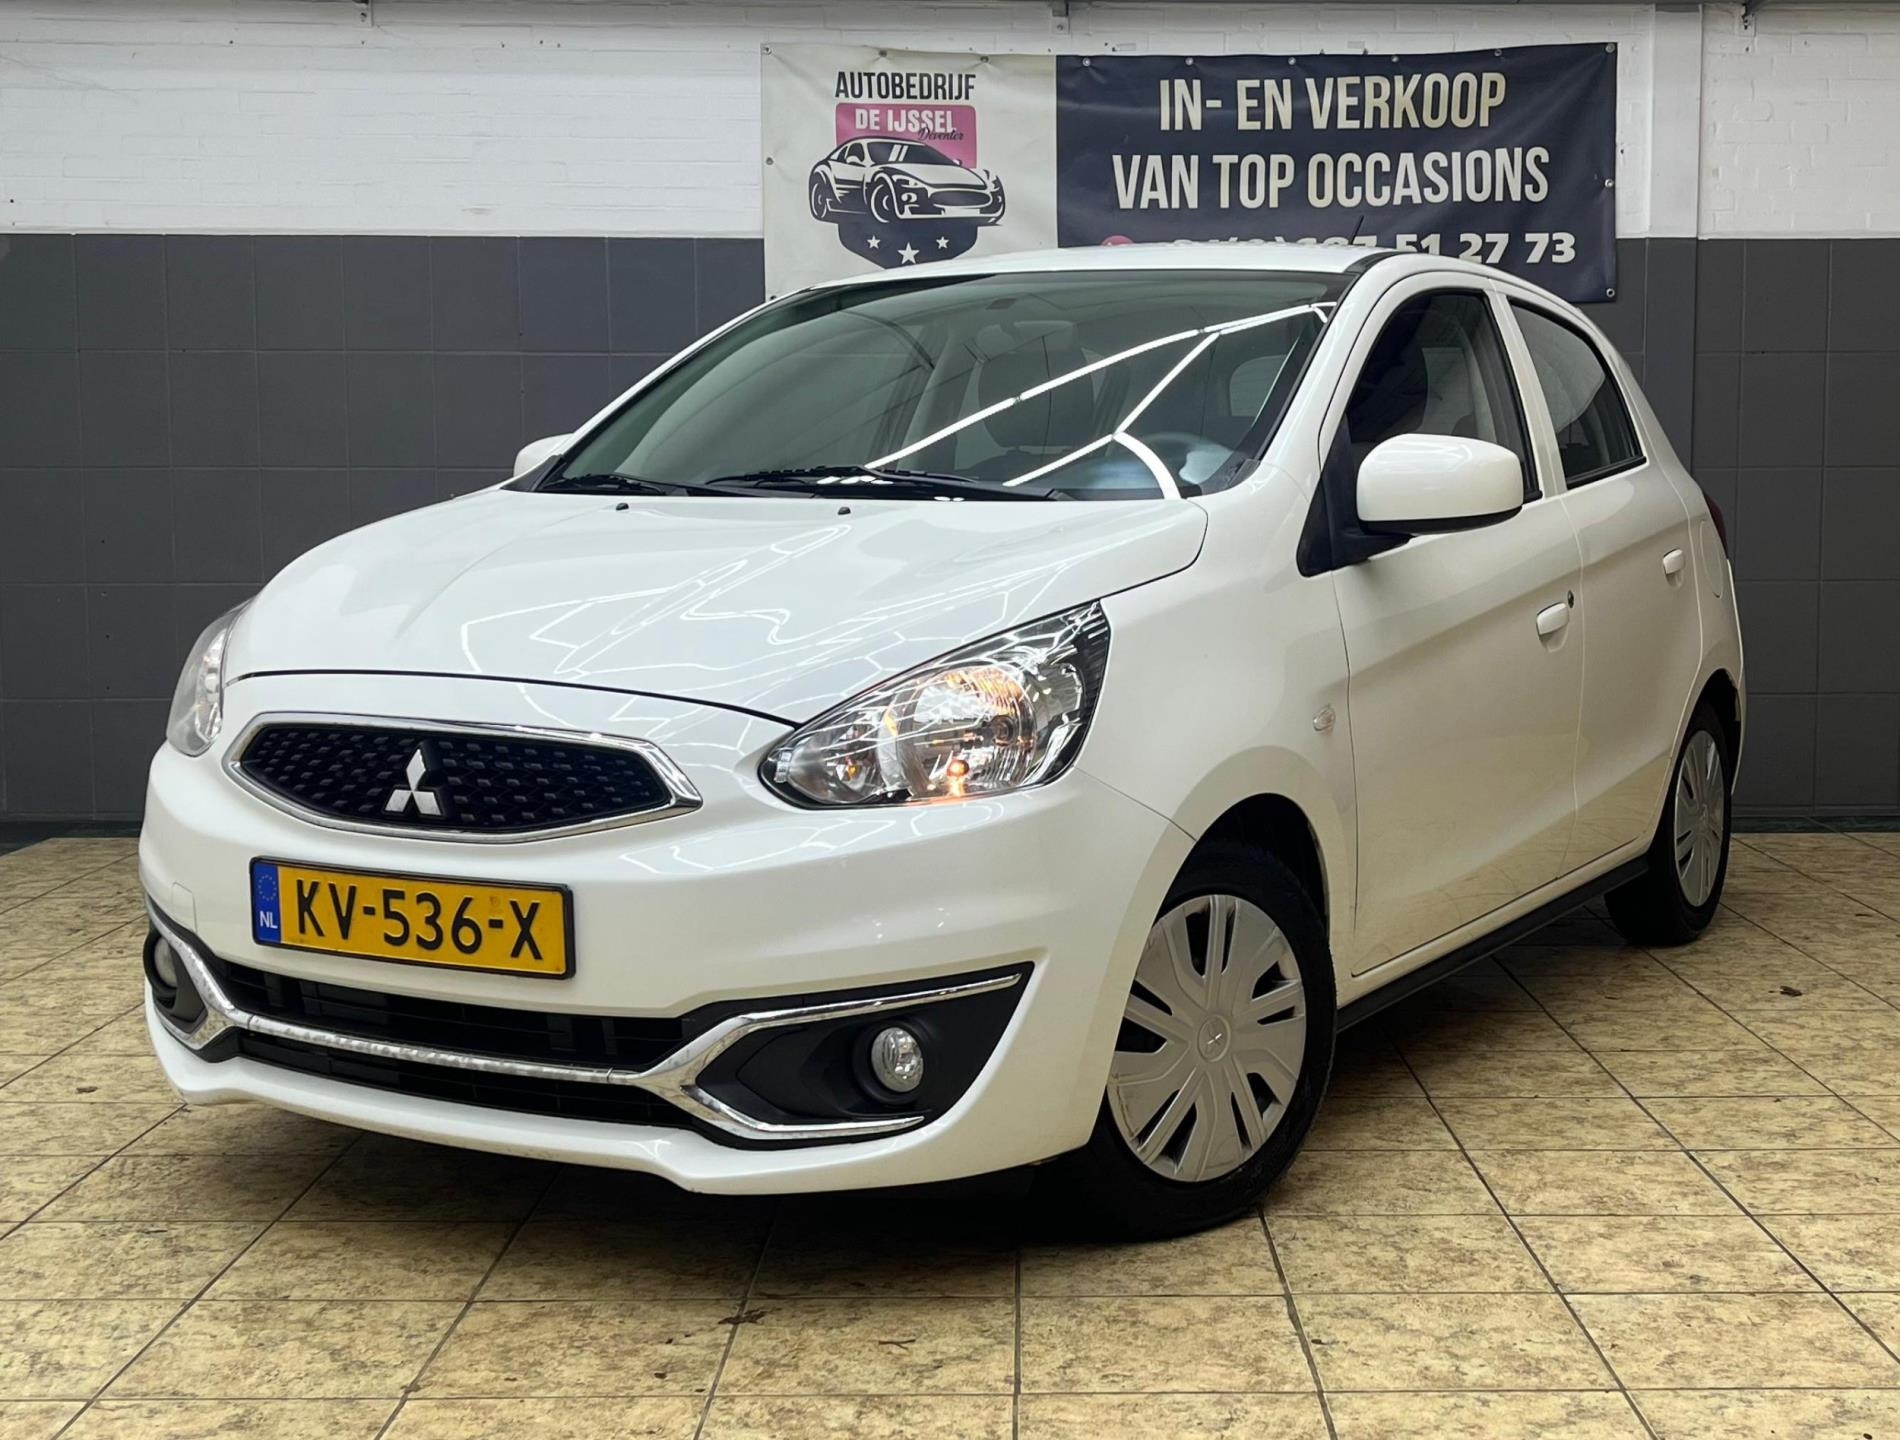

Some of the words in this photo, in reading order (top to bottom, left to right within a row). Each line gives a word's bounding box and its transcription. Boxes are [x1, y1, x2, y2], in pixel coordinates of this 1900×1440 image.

[835, 71, 976, 100] AUTOBEDRIJF
[1159, 79, 1222, 131] IN-
[1236, 78, 1293, 130] EN
[1305, 72, 1506, 129] VERKOOP
[855, 109, 880, 130] DE
[887, 109, 956, 132] IJSSEL
[1112, 154, 1198, 209] VAN
[1212, 153, 1295, 208] TOP
[1307, 146, 1550, 208] OCCASIONS
[1459, 233, 1509, 264] 27
[1525, 232, 1576, 264] 73
[260, 910, 278, 929] NL
[296, 879, 544, 960] KV-536-X
